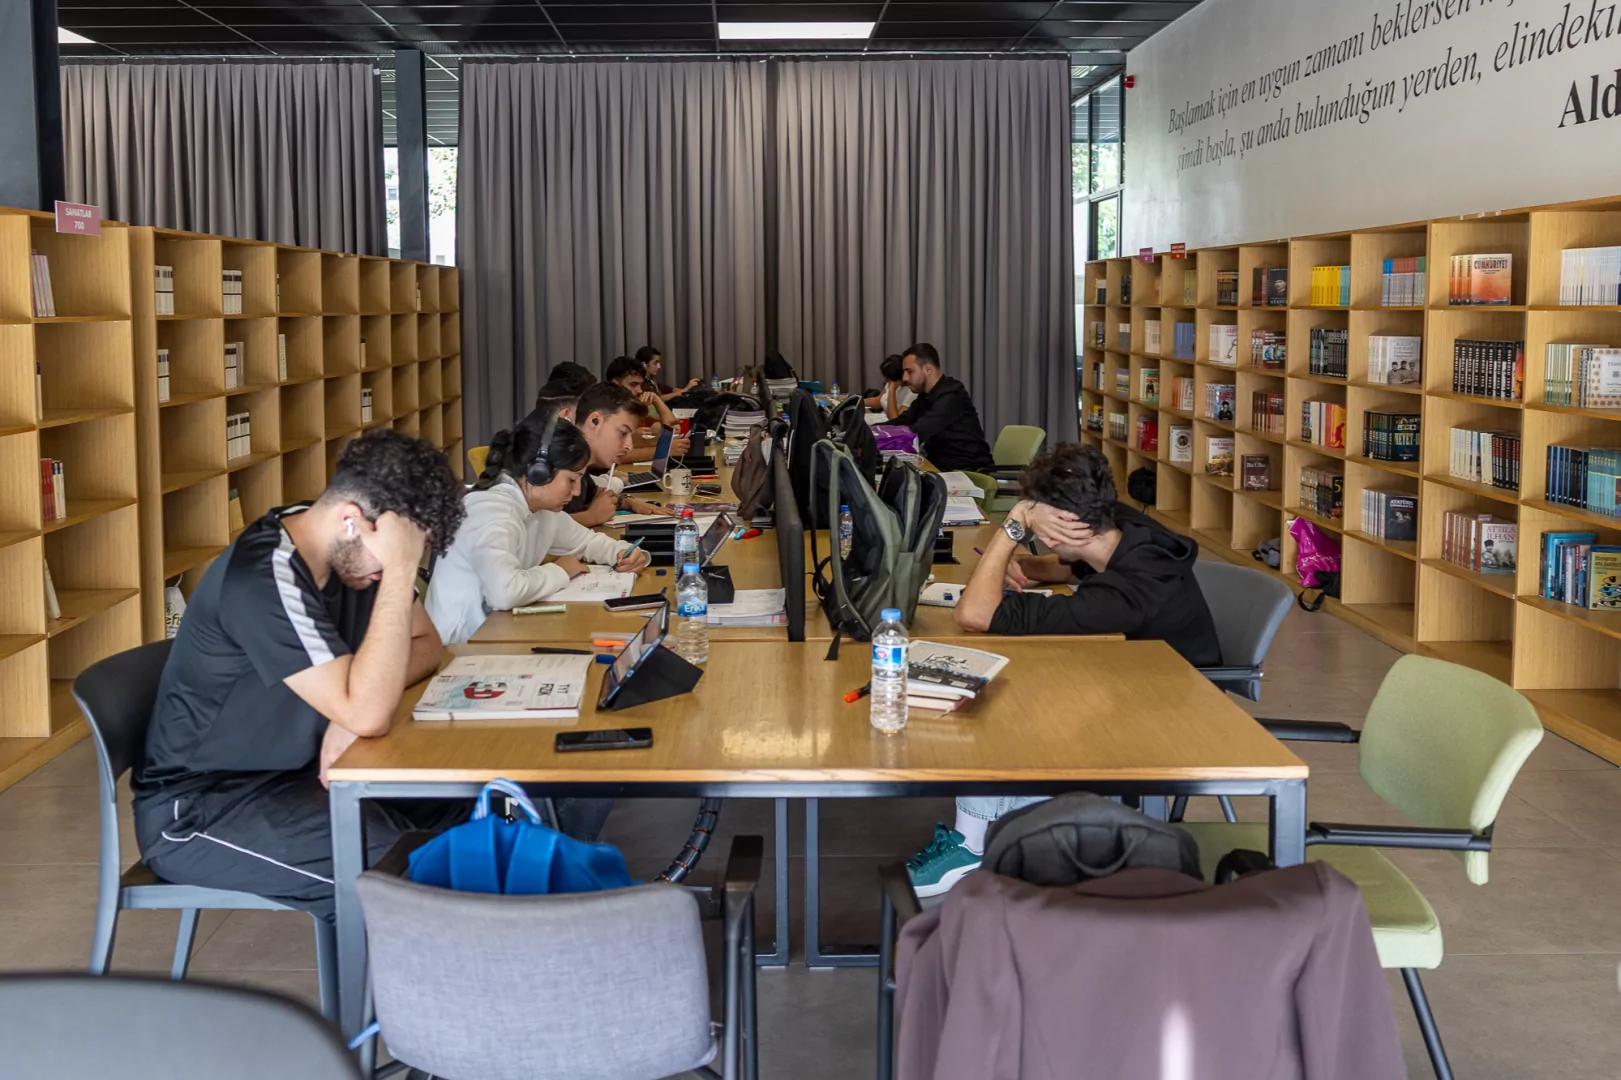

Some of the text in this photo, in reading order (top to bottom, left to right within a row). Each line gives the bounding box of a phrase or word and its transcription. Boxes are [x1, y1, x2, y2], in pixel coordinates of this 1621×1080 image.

[1168, 90, 1216, 135] Başlamak
[1218, 84, 1238, 119] için
[1241, 80, 1256, 104] en
[1259, 60, 1300, 102] uygun
[1304, 32, 1364, 78] zamanı
[1176, 139, 1204, 178] şimdi
[1206, 129, 1236, 166] başla,
[1240, 130, 1254, 159] şu
[1256, 108, 1291, 146] anda
[1294, 78, 1396, 134] bulunduğun
[1398, 46, 1482, 113] yerden,
[65, 207, 92, 219] SANATLAR
[74, 220, 85, 230] 700
